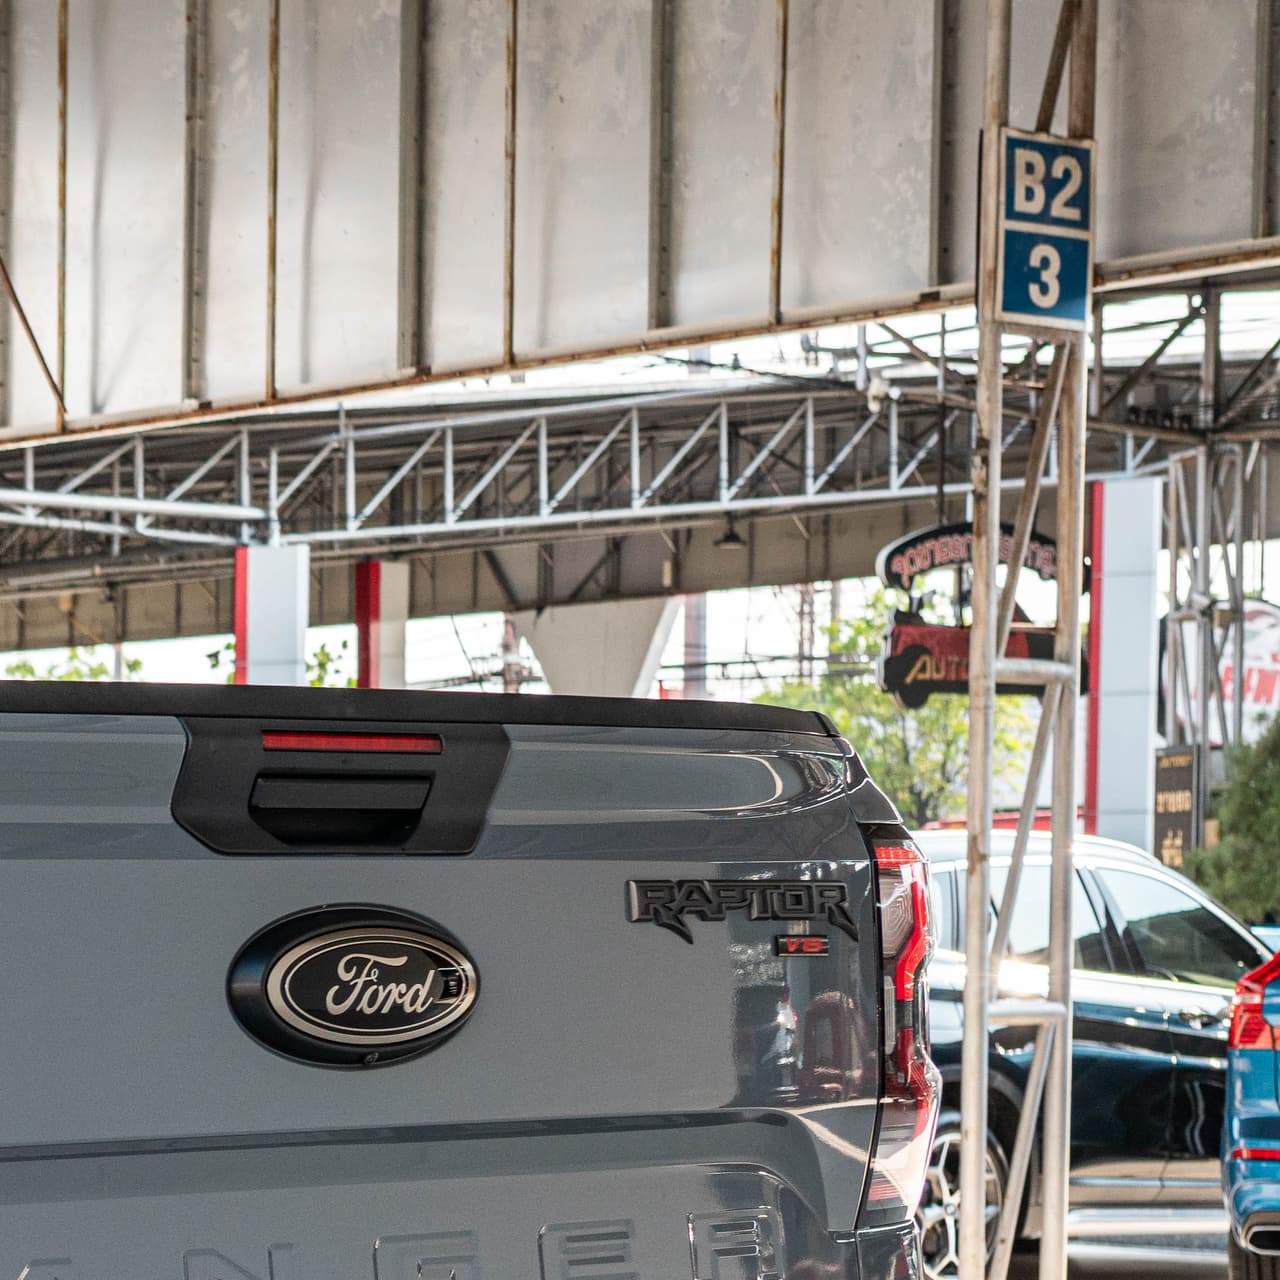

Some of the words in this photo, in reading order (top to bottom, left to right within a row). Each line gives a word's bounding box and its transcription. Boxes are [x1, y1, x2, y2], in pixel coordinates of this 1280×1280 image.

[1013, 147, 1083, 222] B2
[1028, 243, 1061, 309] 3
[624, 879, 859, 944] RAPTOR
[785, 937, 824, 954] V6
[325, 953, 436, 1016] Ford
